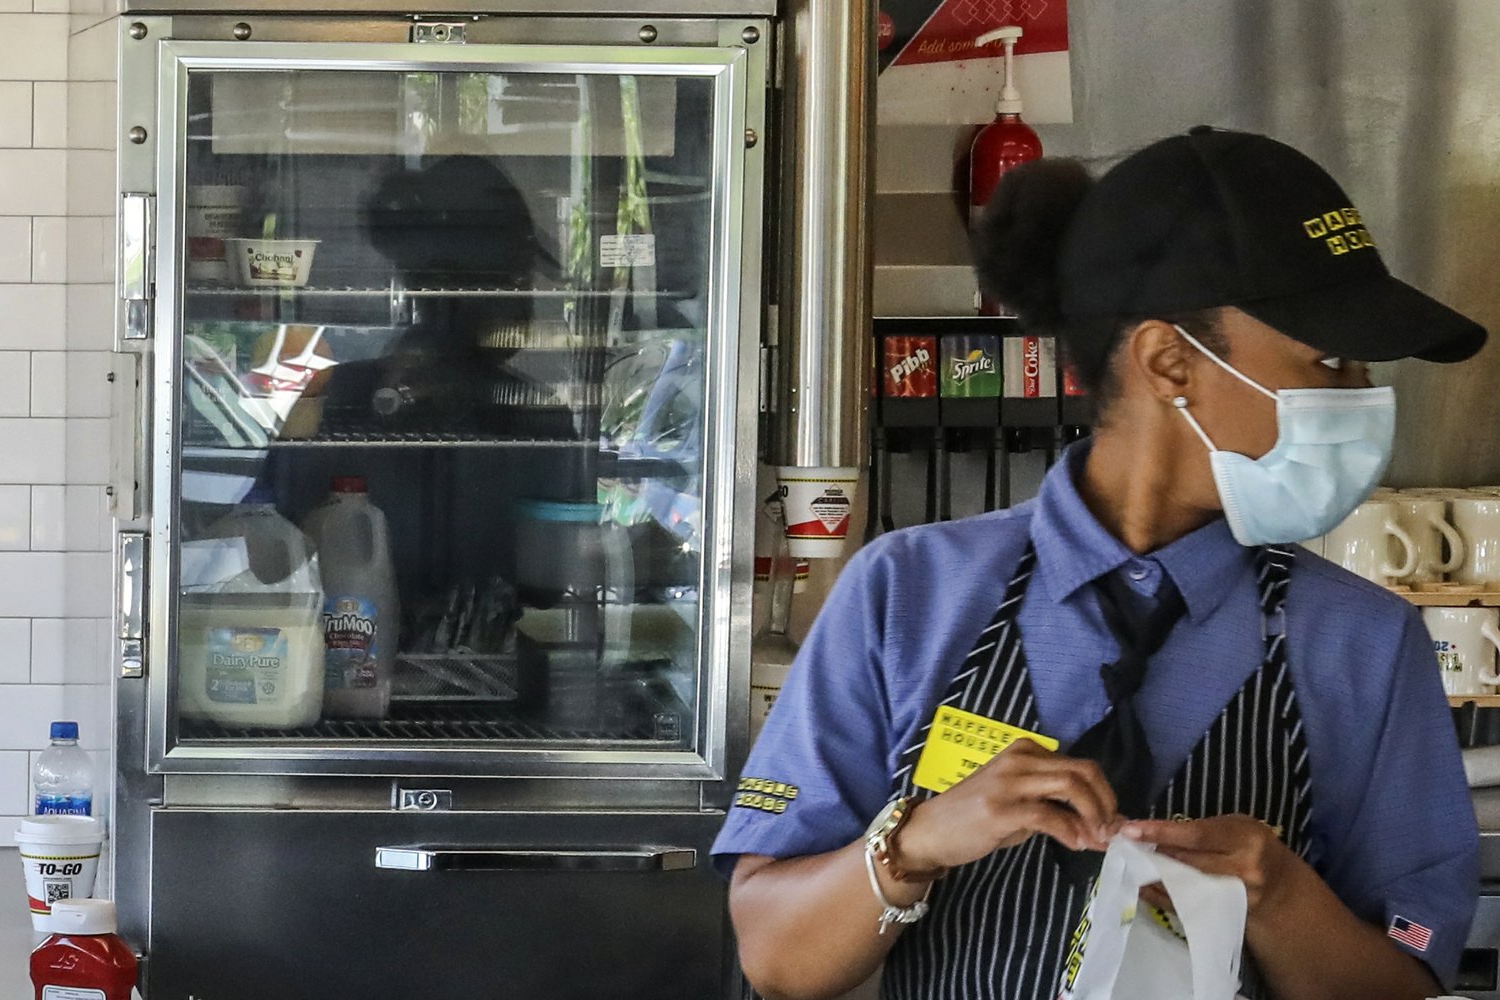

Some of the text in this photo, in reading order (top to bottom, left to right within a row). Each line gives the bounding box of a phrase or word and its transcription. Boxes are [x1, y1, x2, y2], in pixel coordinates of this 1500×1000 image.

[917, 37, 945, 53] Add
[948, 40, 977, 52] som
[255, 253, 294, 264] Chobani
[889, 347, 930, 385] Pibb
[952, 355, 992, 381] Sprite
[1024, 341, 1039, 378] Coke
[323, 613, 374, 635] TruMoo
[212, 653, 280, 669] DairyPure
[942, 713, 1012, 744] WAFFLE
[942, 730, 1001, 754] HOUSE
[38, 862, 82, 876] TO-GO
